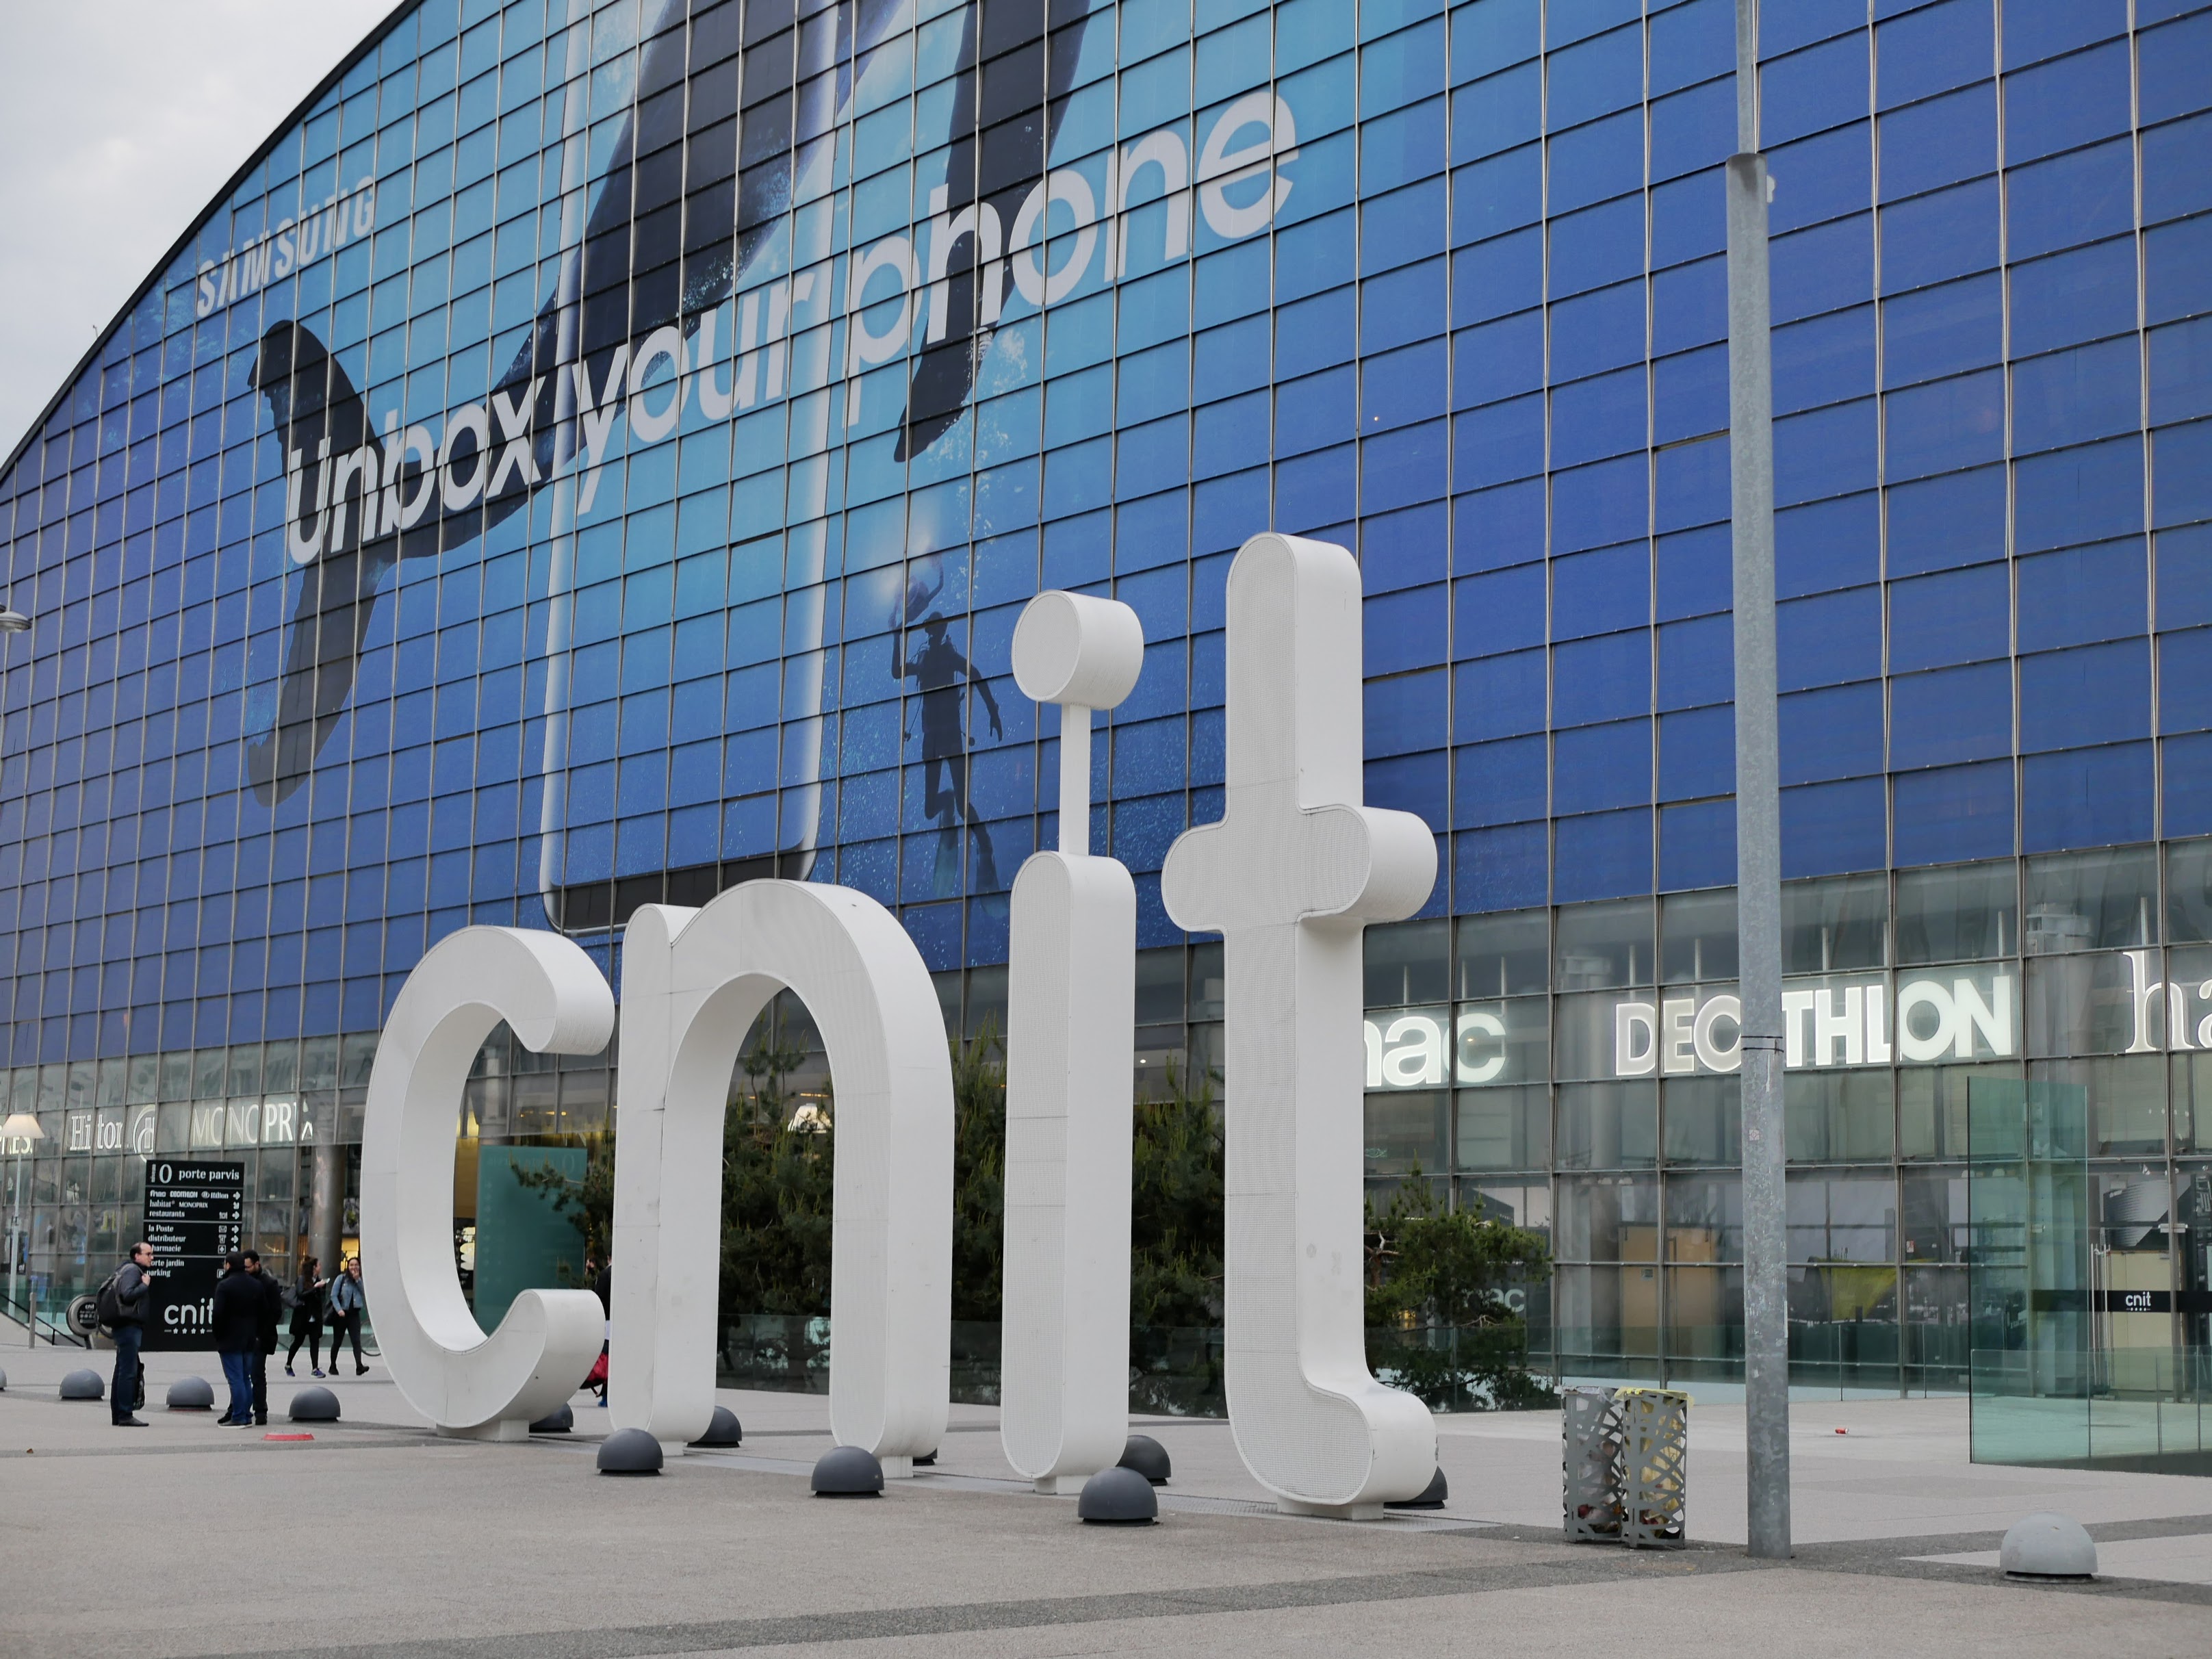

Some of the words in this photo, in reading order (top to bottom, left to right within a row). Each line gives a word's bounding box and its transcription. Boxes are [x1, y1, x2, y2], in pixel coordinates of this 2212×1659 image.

[196, 175, 374, 318] SAMSUNG
[572, 273, 815, 516] your
[840, 91, 1299, 429] phone
[362, 531, 1437, 1509] cnit
[1615, 975, 2012, 1076] DECTHLON
[179, 1169, 206, 1181] porte
[209, 1169, 240, 1181] parvis
[148, 1234, 186, 1242] distributeur
[152, 1244, 181, 1252] harmacie
[166, 1259, 185, 1268] jardin
[2125, 1291, 2151, 1307] cnit
